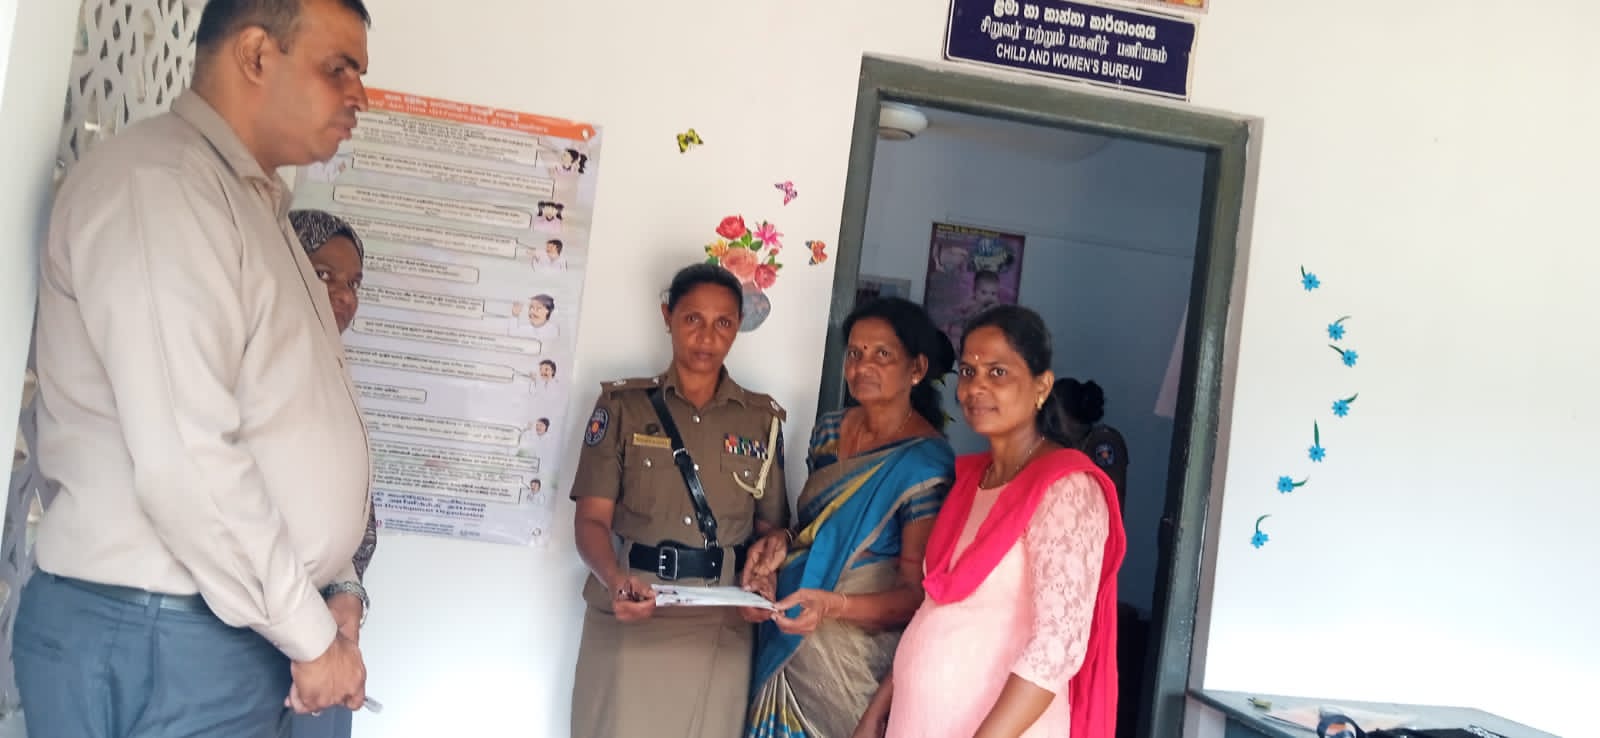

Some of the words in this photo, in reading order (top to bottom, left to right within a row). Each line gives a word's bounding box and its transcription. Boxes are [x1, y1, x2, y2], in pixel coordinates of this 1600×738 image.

[1024, 3, 1040, 20] හා
[981, 16, 1021, 40] சிறுவர்
[1025, 24, 1066, 48] மற்றும்
[1069, 33, 1110, 56] மகளிர்
[1117, 41, 1168, 64] பணியகம்
[996, 43, 1027, 61] CHILD
[1028, 48, 1050, 65] AND
[1052, 52, 1099, 74] WOMEN'S
[1101, 60, 1143, 81] BUREAU
